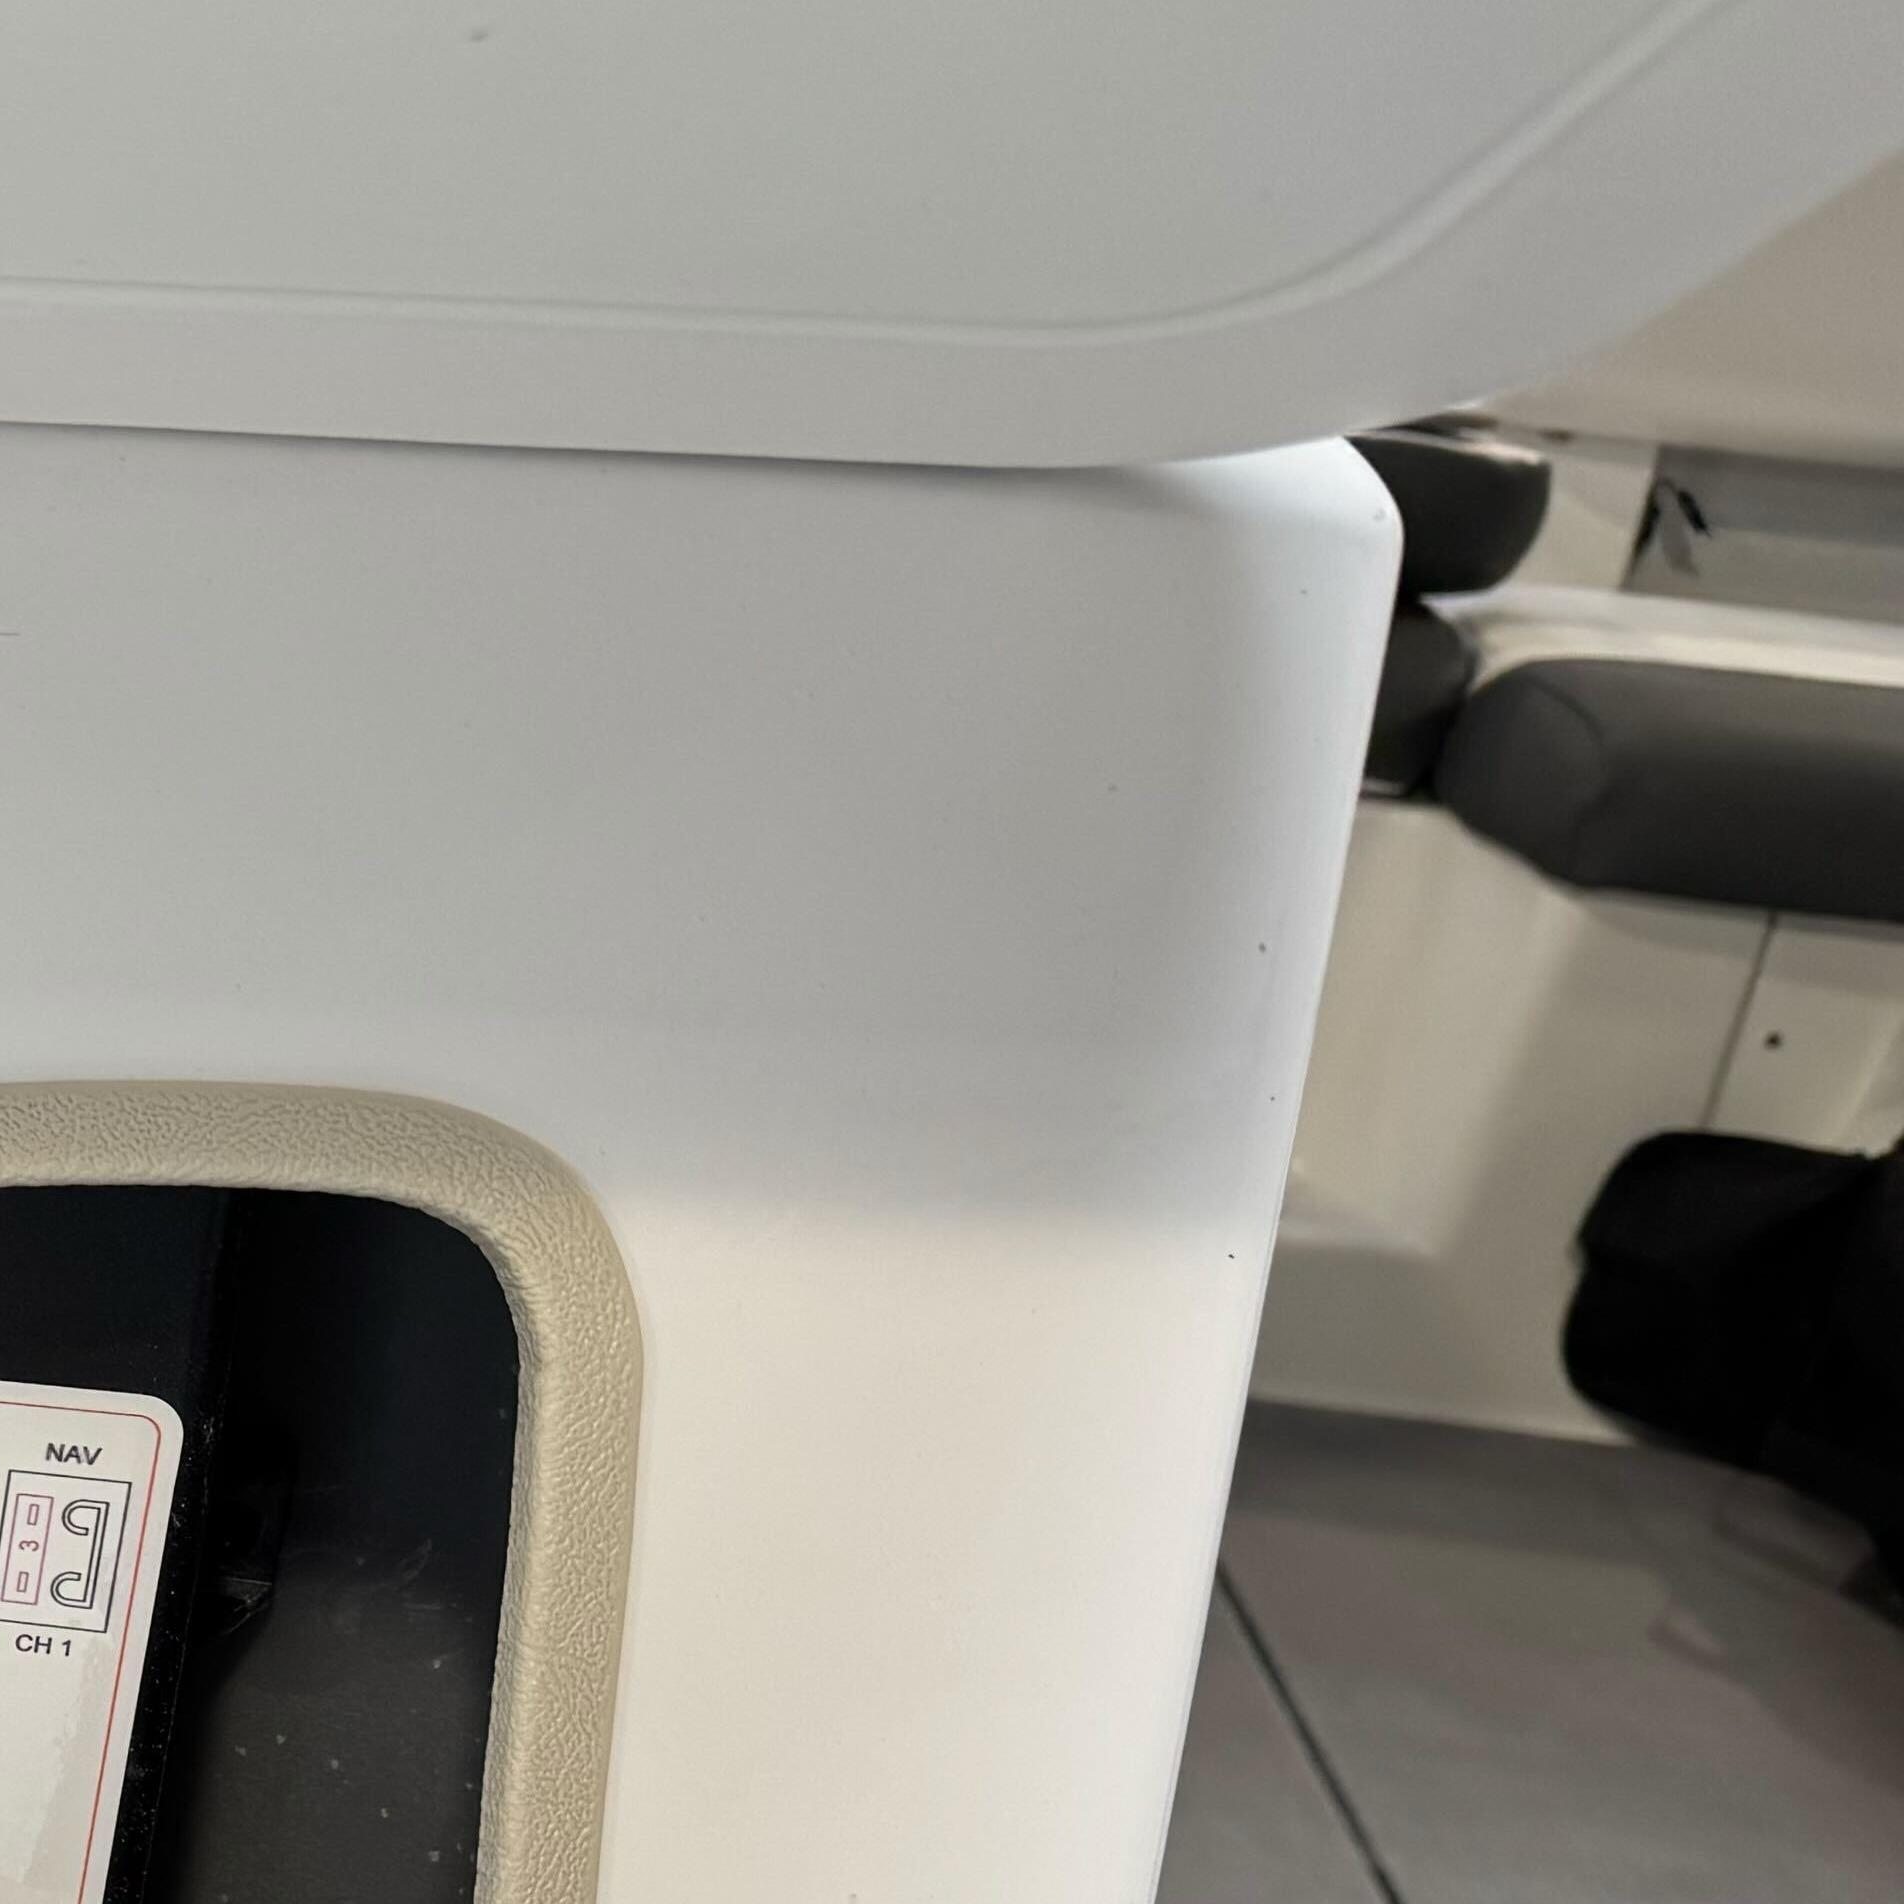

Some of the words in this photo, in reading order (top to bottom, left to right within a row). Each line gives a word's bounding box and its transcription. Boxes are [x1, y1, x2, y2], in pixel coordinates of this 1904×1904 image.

[45, 1442, 103, 1466] NAV
[15, 1633, 53, 1655] CH
[62, 1639, 72, 1657] 1
